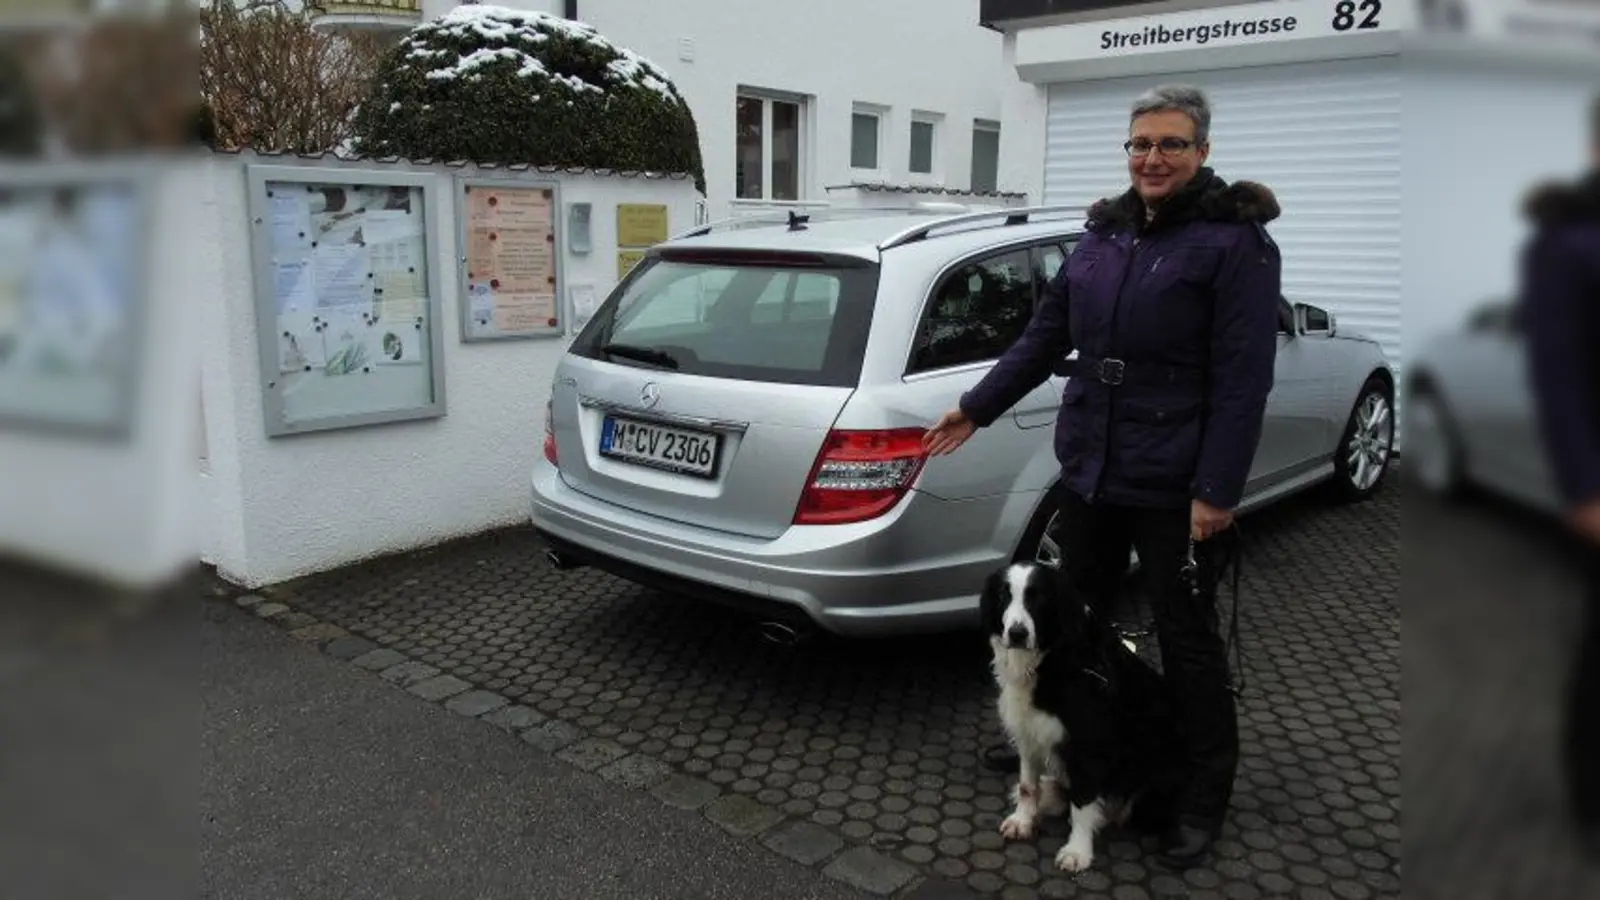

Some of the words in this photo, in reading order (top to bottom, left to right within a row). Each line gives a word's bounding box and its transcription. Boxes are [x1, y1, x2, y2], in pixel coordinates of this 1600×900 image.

[1100, 16, 1297, 49] Streitbergstrasse
[1332, 0, 1381, 31] 82
[662, 433, 711, 466] 2306
